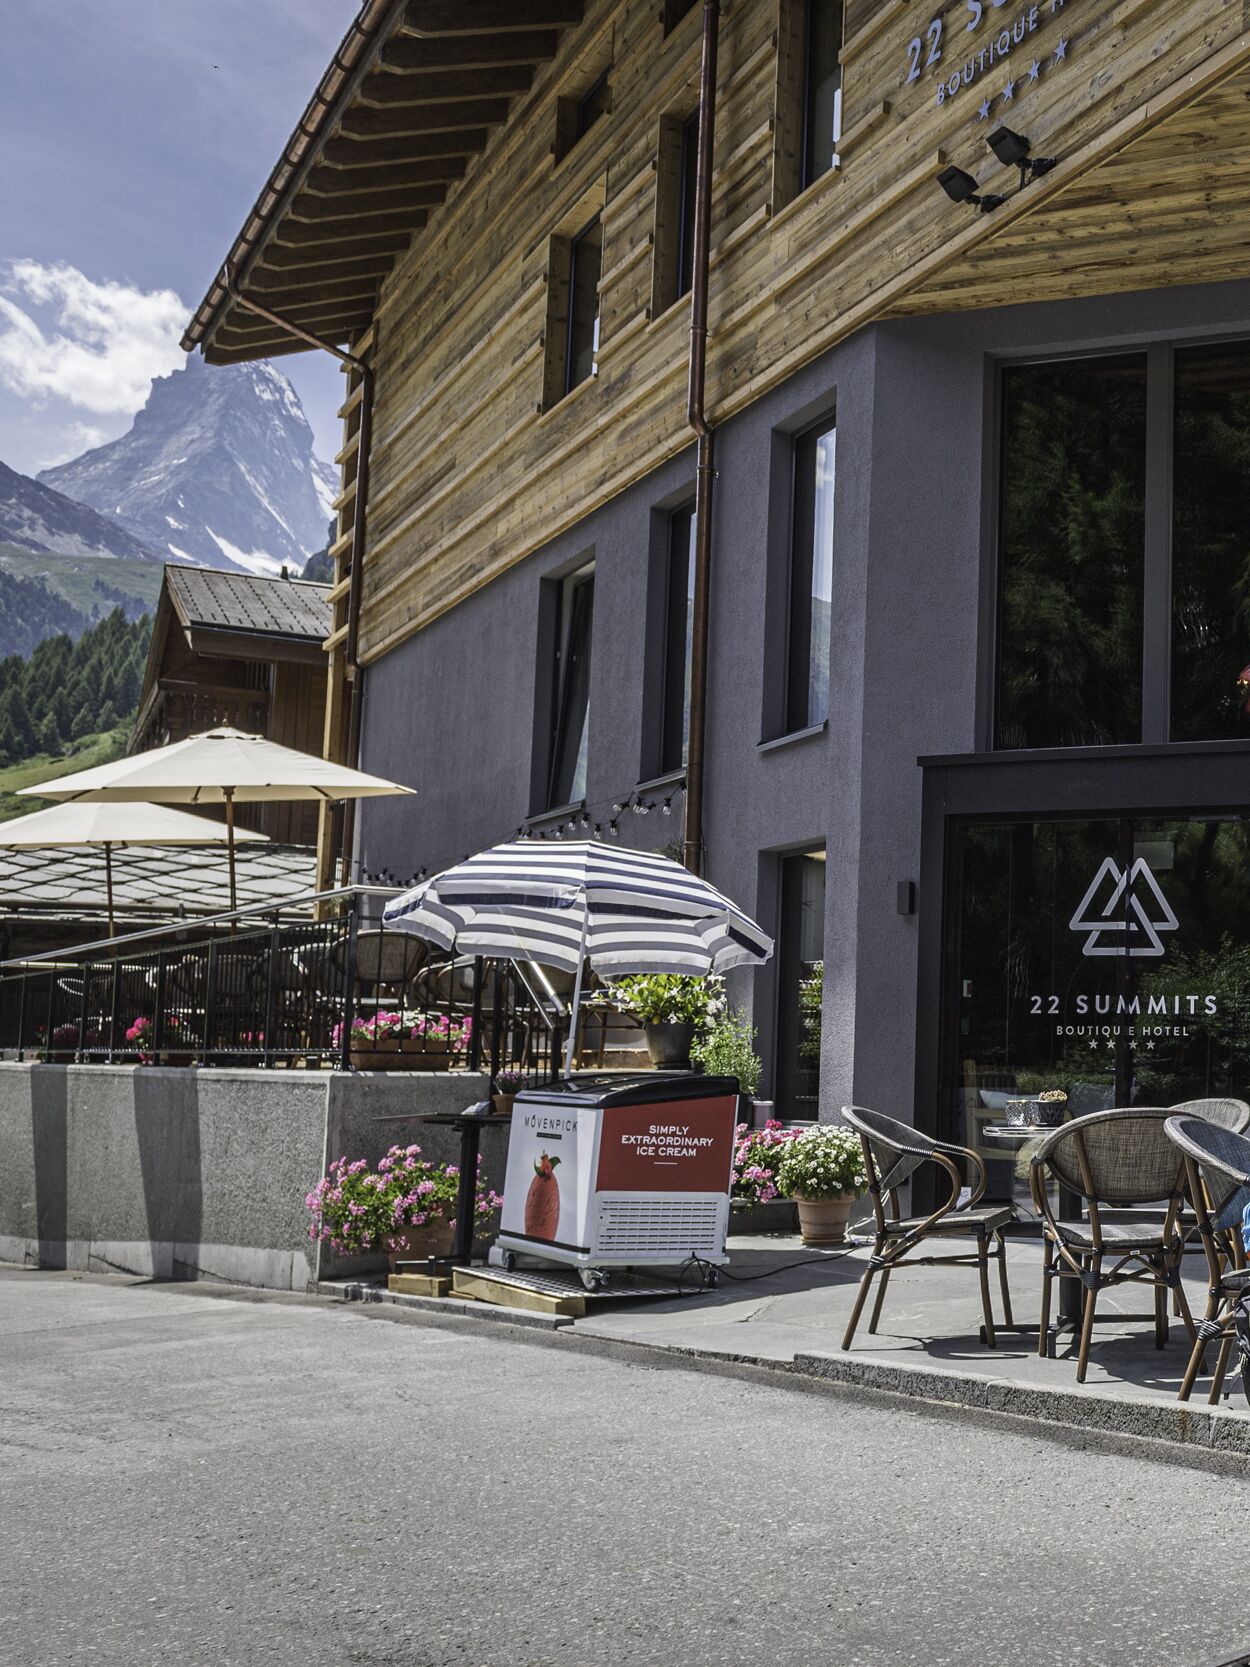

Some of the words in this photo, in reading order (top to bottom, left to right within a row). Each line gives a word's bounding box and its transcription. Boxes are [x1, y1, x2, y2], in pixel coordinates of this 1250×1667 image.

[904, 19, 942, 85] 22
[936, 6, 1039, 106] BOUTIQUE
[1030, 995, 1060, 1014] 22
[1076, 994, 1218, 1015] SUMMITS
[1056, 1025, 1135, 1037] BOUTIQUE
[1142, 1026, 1189, 1037] HOTEL
[648, 1125, 690, 1136] SIMPLY
[621, 1134, 714, 1147] EXTRAORDINARY
[636, 1146, 656, 1156] ICE
[658, 1147, 697, 1157] CREAM
